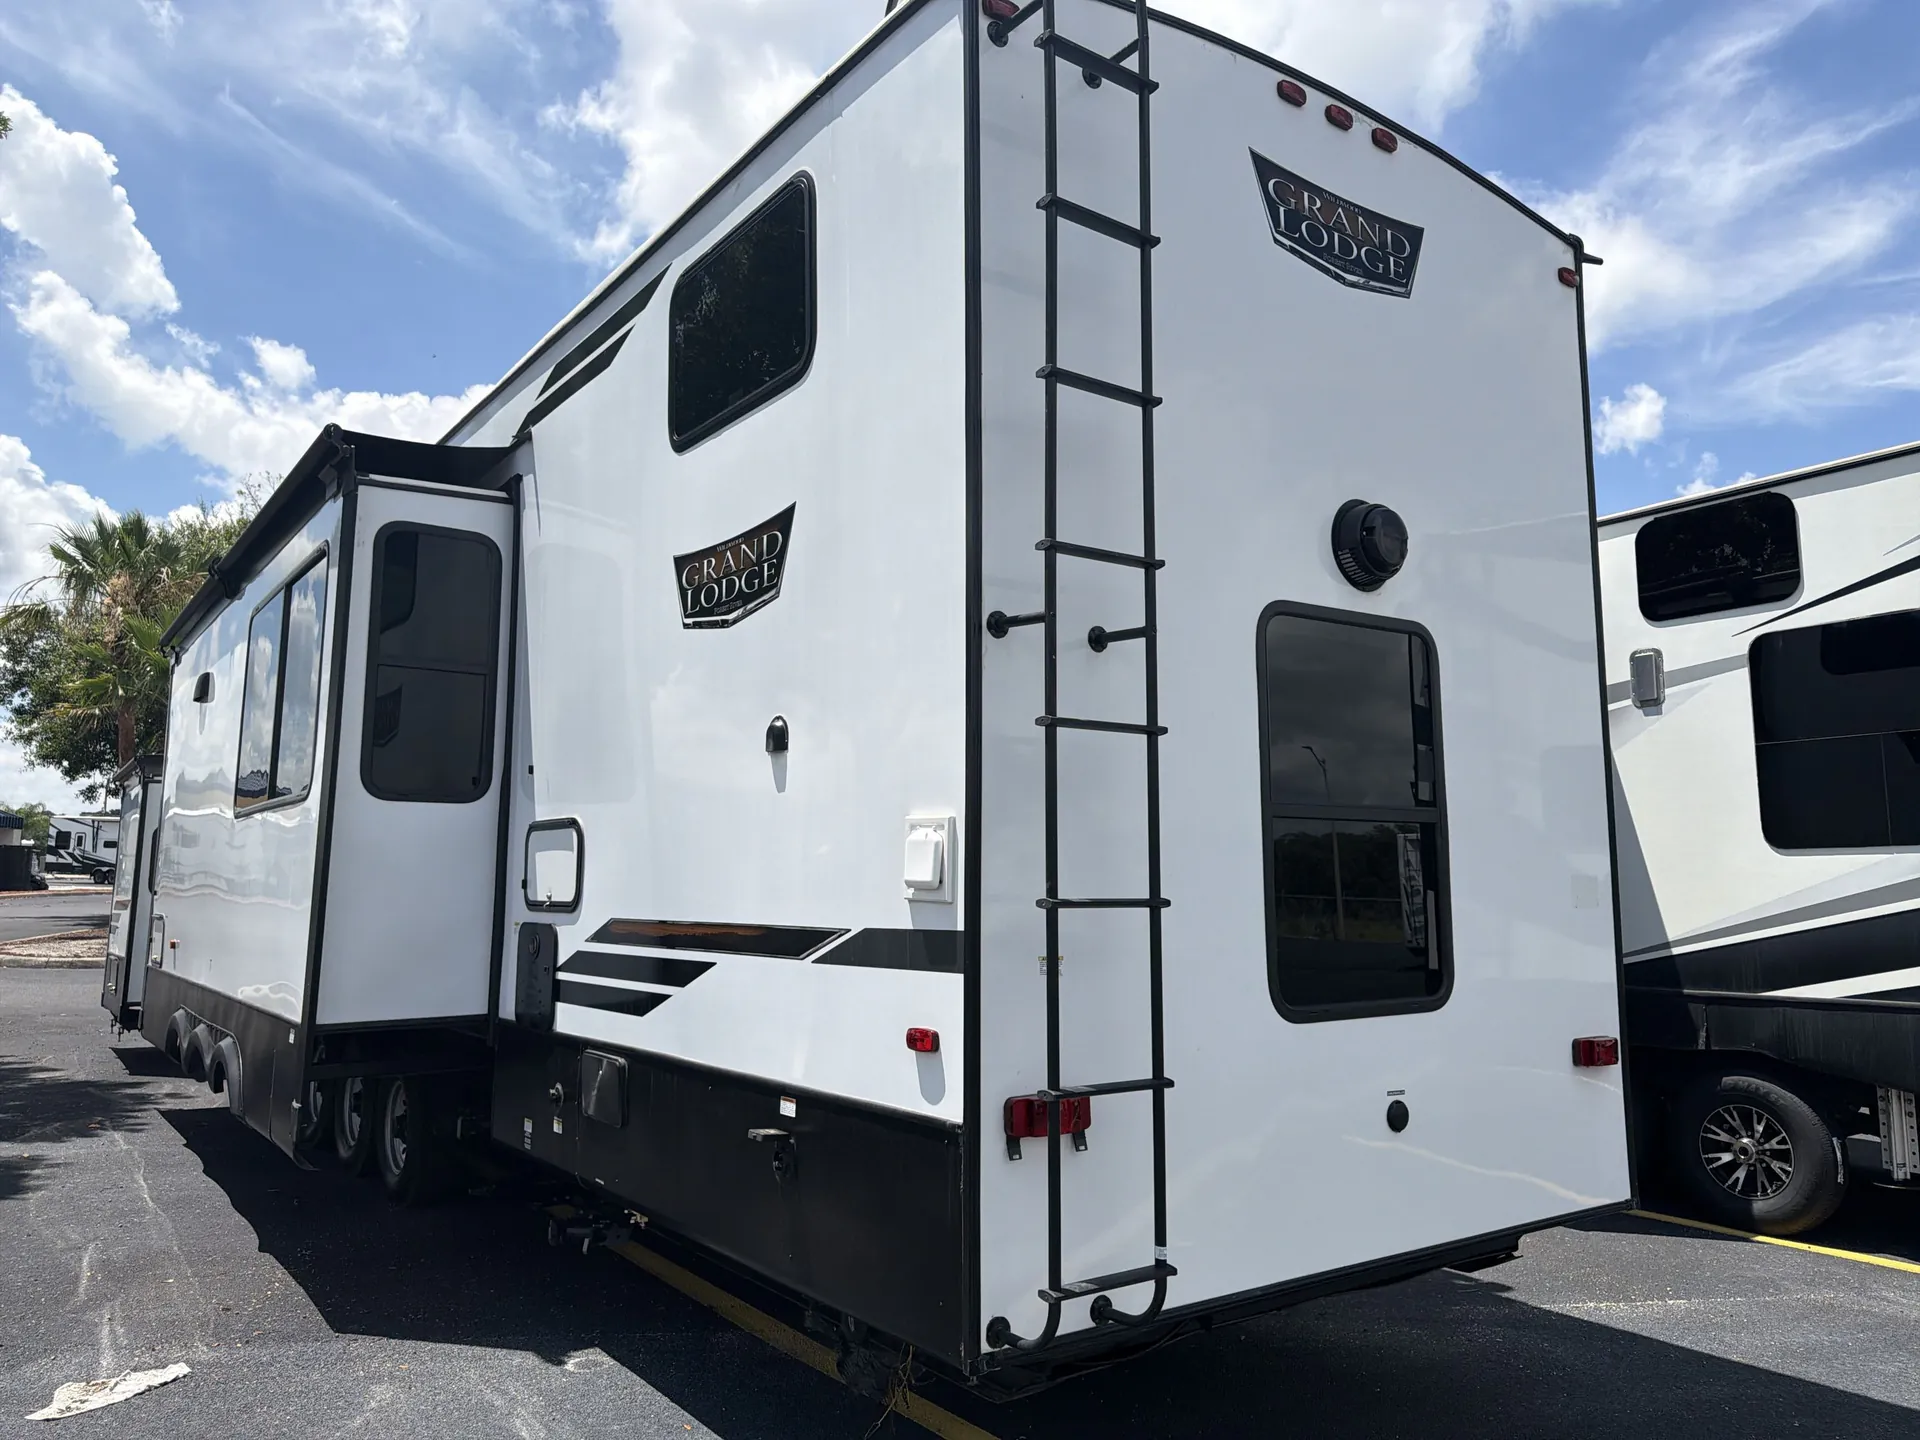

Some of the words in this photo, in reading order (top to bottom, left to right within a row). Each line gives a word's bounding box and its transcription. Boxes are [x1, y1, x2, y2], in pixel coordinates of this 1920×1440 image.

[1268, 178, 1411, 258] GRAND
[1276, 205, 1407, 283] LODGE
[682, 531, 783, 589] GRAND
[685, 559, 778, 615] LODGE
